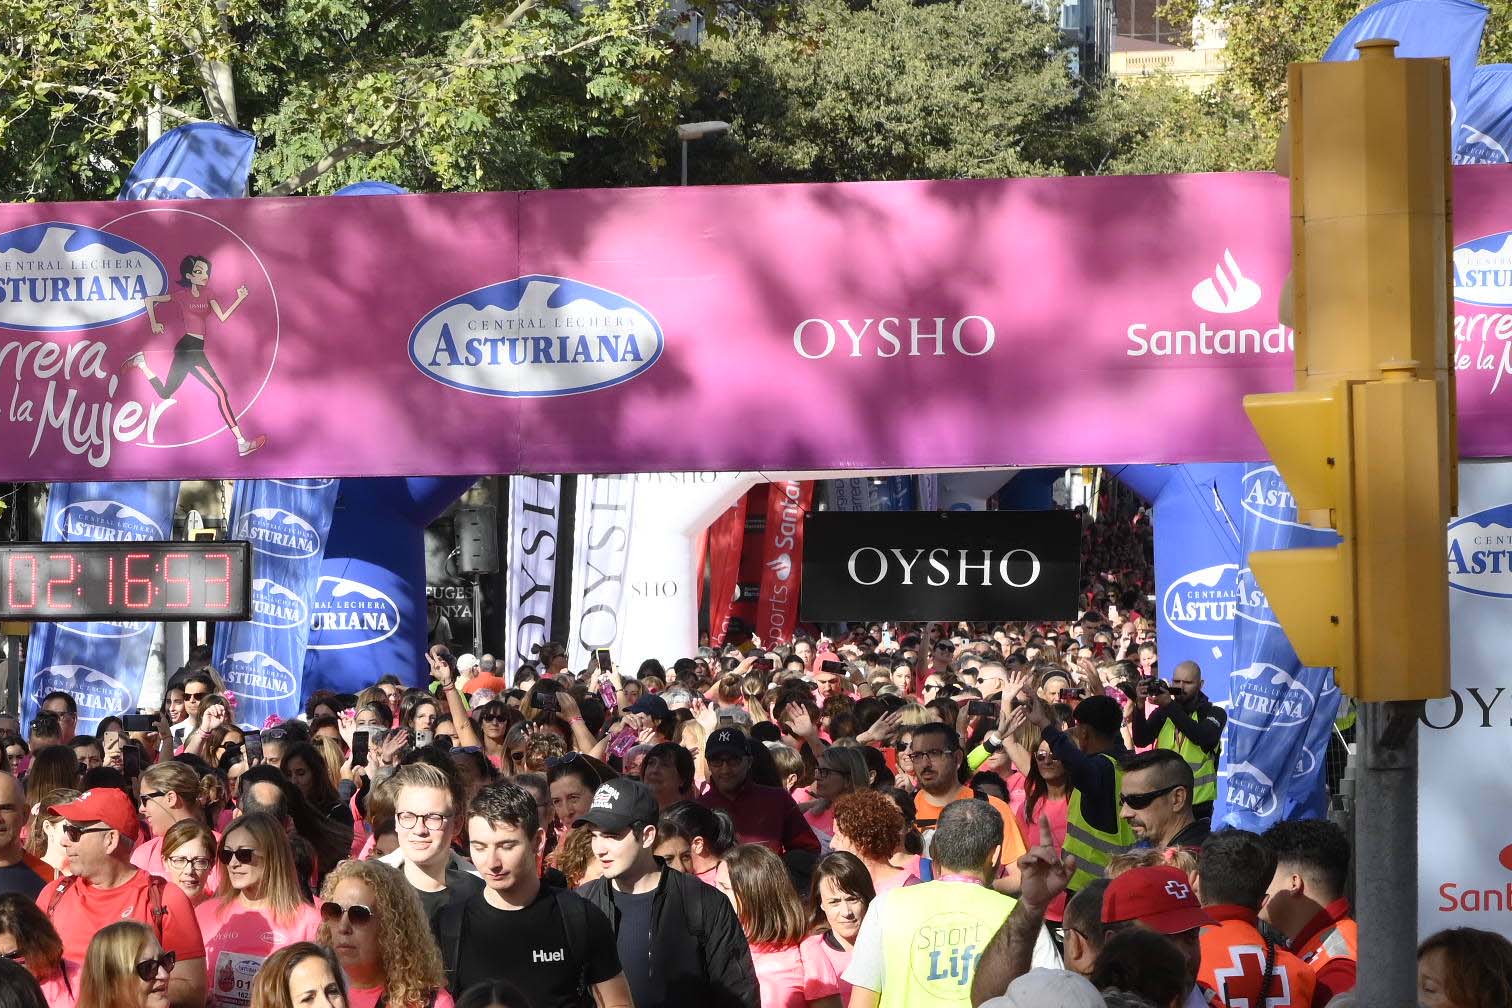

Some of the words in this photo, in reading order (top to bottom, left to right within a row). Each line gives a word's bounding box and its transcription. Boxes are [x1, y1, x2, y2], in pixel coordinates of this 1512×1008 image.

[71, 258, 143, 270] LECHERA
[467, 319, 546, 331] CENTRAL
[550, 317, 635, 330] LECHERA
[793, 315, 996, 359] OYSHO
[428, 321, 643, 368] ASTURIANA
[9, 384, 33, 422] la
[30, 373, 177, 467] Mujer
[239, 519, 313, 553] ASTURIANA
[516, 475, 557, 667] OYSH
[579, 473, 628, 651] OYSH
[847, 546, 1042, 589] OYSHO
[7, 553, 232, 609] 02:16:53
[425, 585, 474, 599] FUGES
[1187, 590, 1236, 599] CENTRAL
[311, 612, 391, 631] URIANA
[336, 601, 386, 610] LECHERA
[1170, 591, 1237, 621] ASTUR
[1419, 688, 1512, 730] OY
[918, 920, 984, 953] Sport
[533, 948, 564, 963] Huel
[236, 979, 251, 990] 01
